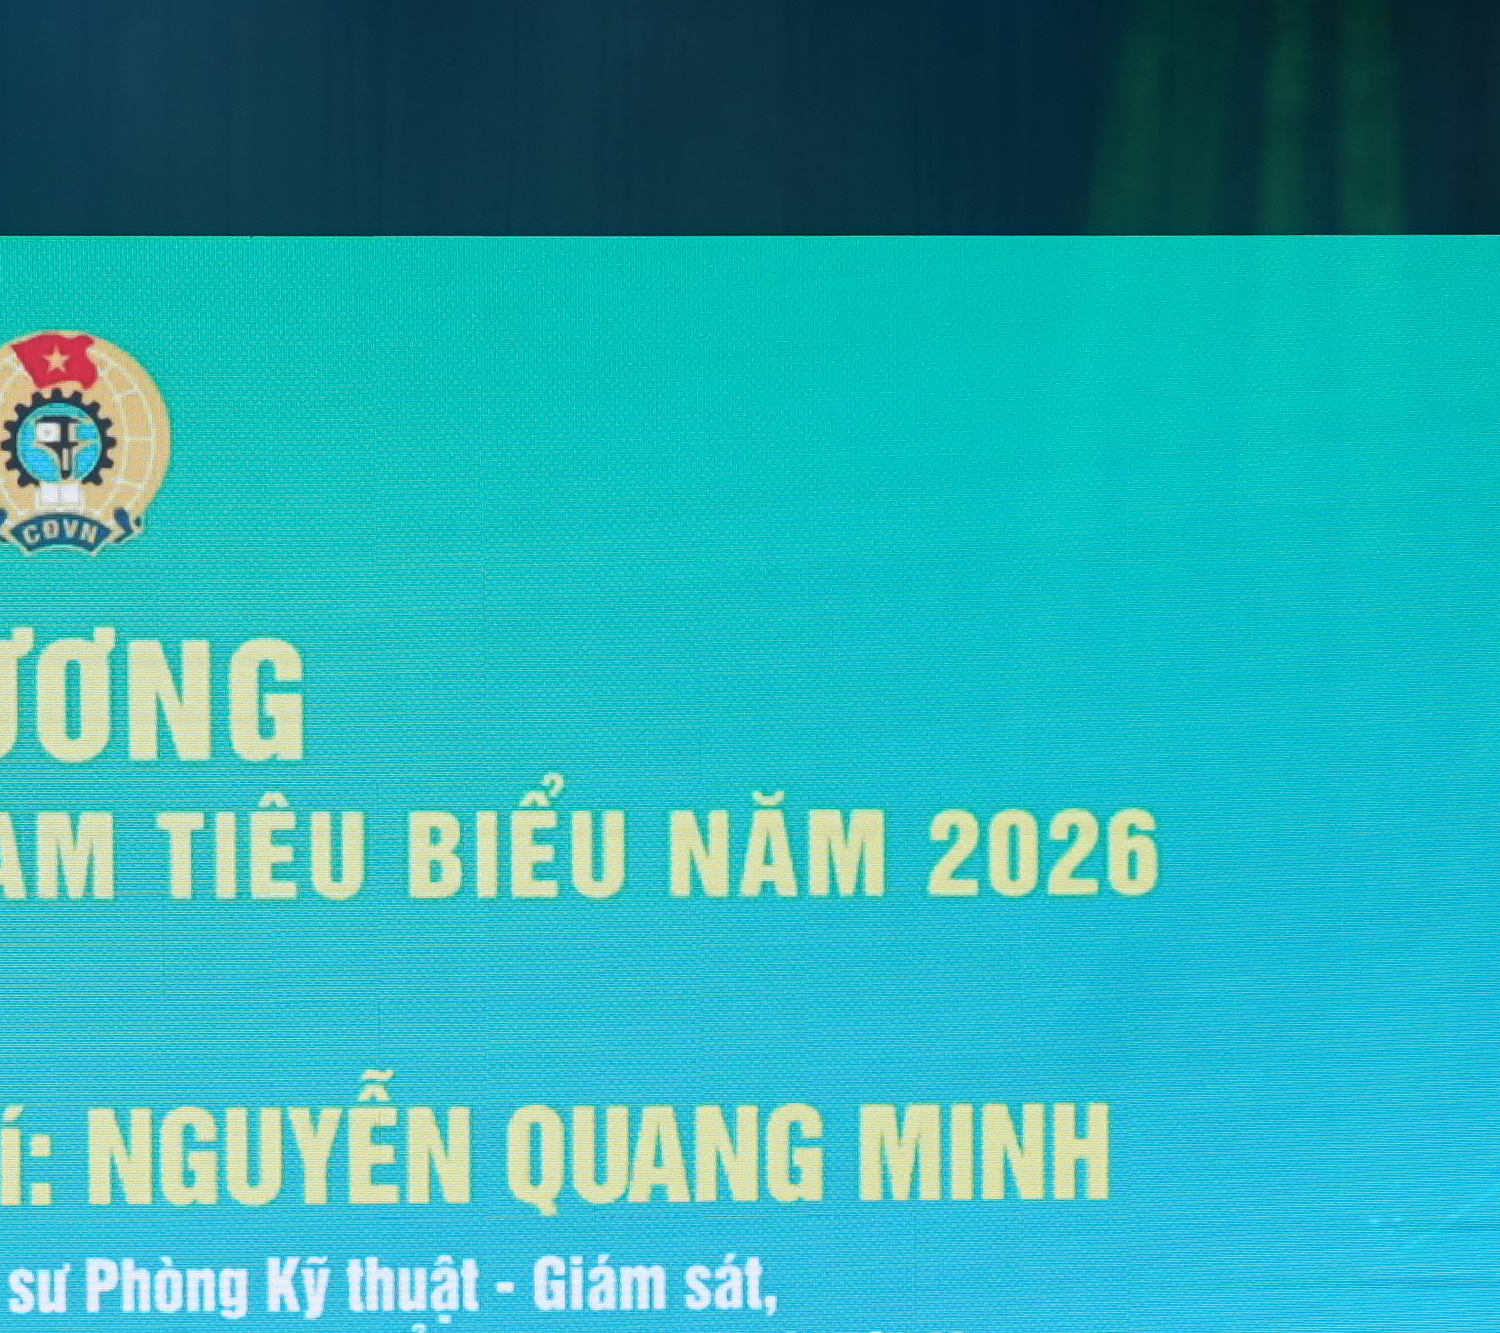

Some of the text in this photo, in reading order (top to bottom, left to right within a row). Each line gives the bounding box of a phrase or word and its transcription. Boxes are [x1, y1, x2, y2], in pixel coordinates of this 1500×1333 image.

[155, 791, 365, 901] TIÊU
[408, 772, 625, 899] BIỂU
[669, 790, 885, 898] NĂM
[927, 807, 1159, 897] 2026
[87, 1069, 471, 1206] NGUYỄN
[506, 1102, 825, 1216] QUANG
[859, 1102, 1110, 1202] MINH
[7, 1262, 72, 1313] sư
[85, 1256, 250, 1320] Phòng
[265, 1256, 331, 1320] Kỹ
[346, 1254, 480, 1324] thuật
[533, 1253, 667, 1311] Giám
[684, 1253, 778, 1316] sát,
